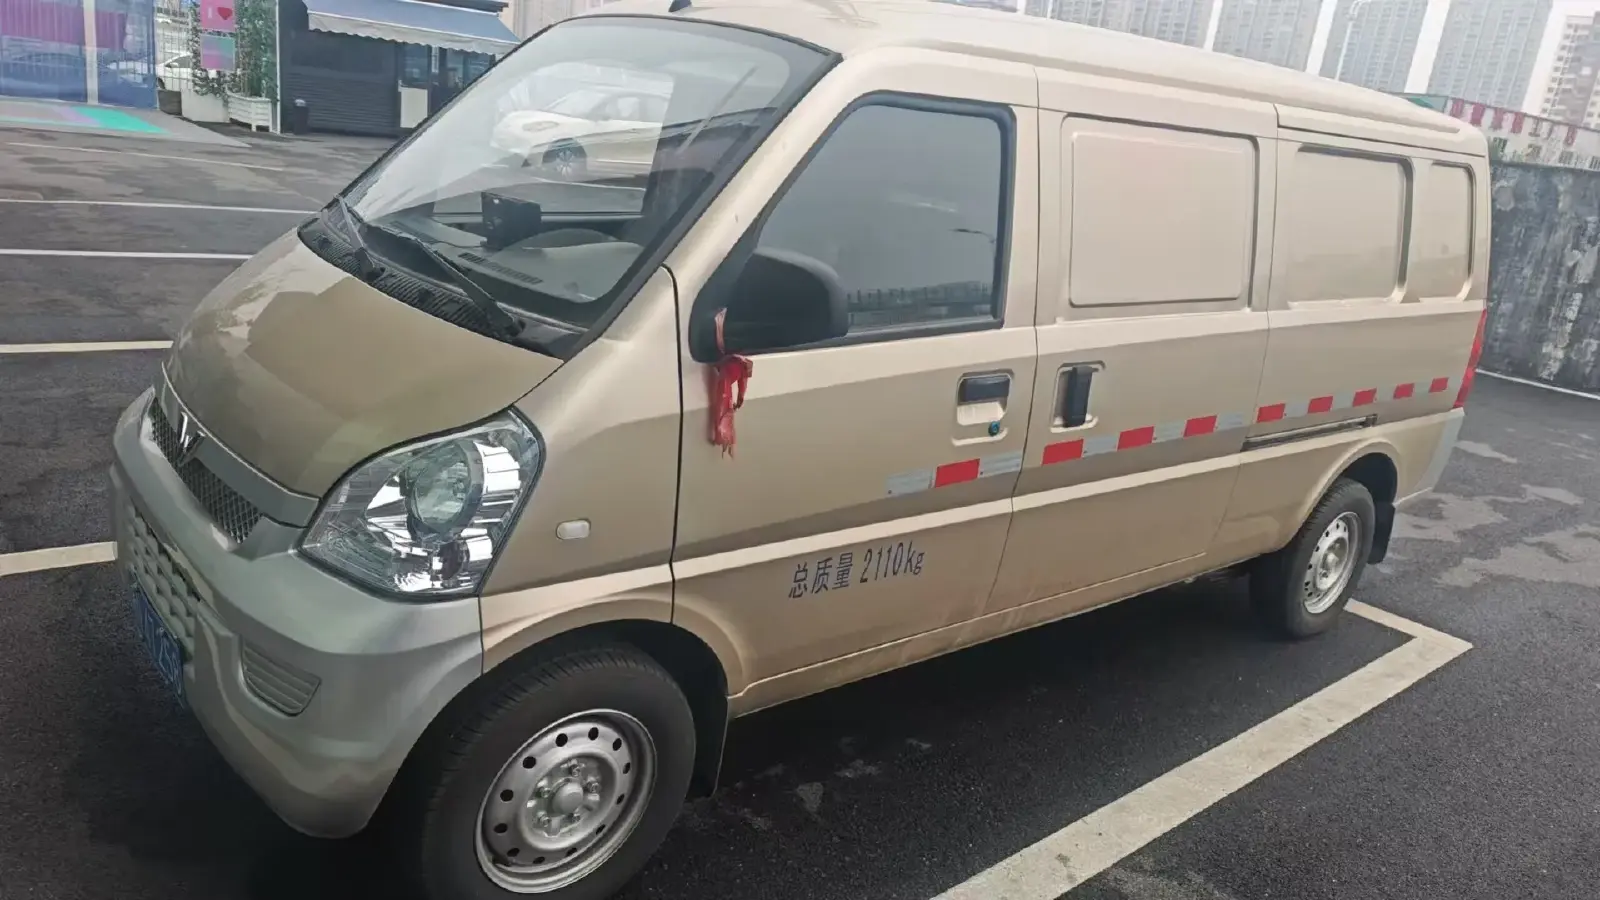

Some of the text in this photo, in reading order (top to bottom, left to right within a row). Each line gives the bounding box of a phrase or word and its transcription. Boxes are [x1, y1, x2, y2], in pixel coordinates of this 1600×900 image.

[788, 540, 926, 599] 总质量 2110kg
